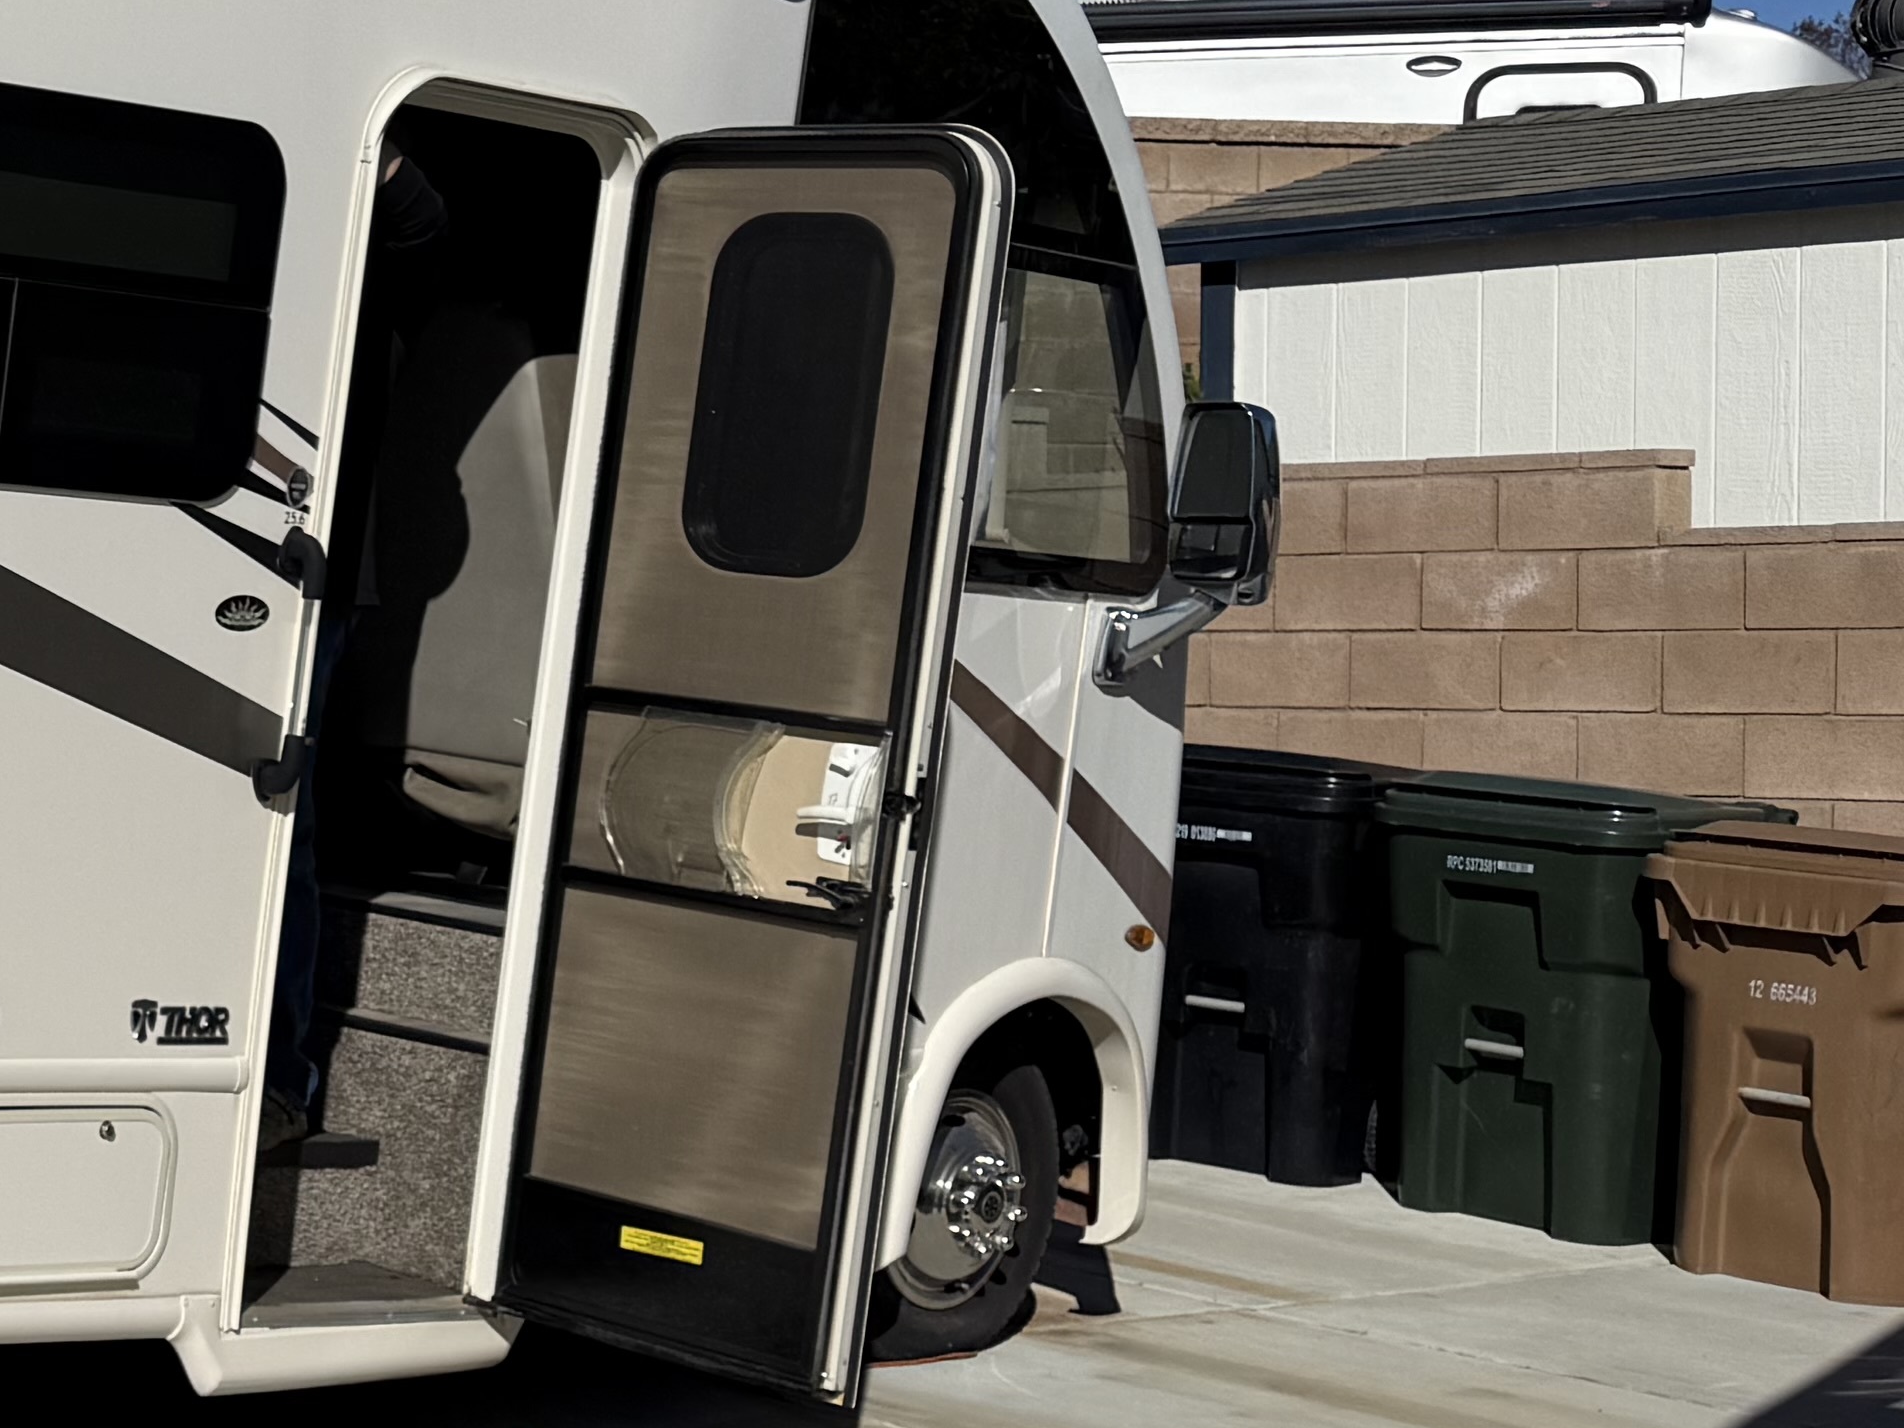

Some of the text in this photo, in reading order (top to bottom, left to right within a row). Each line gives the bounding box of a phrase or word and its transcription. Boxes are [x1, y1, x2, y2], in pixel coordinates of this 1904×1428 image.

[1749, 979, 1817, 1006] 12 665443
[159, 1006, 230, 1038] THOR
